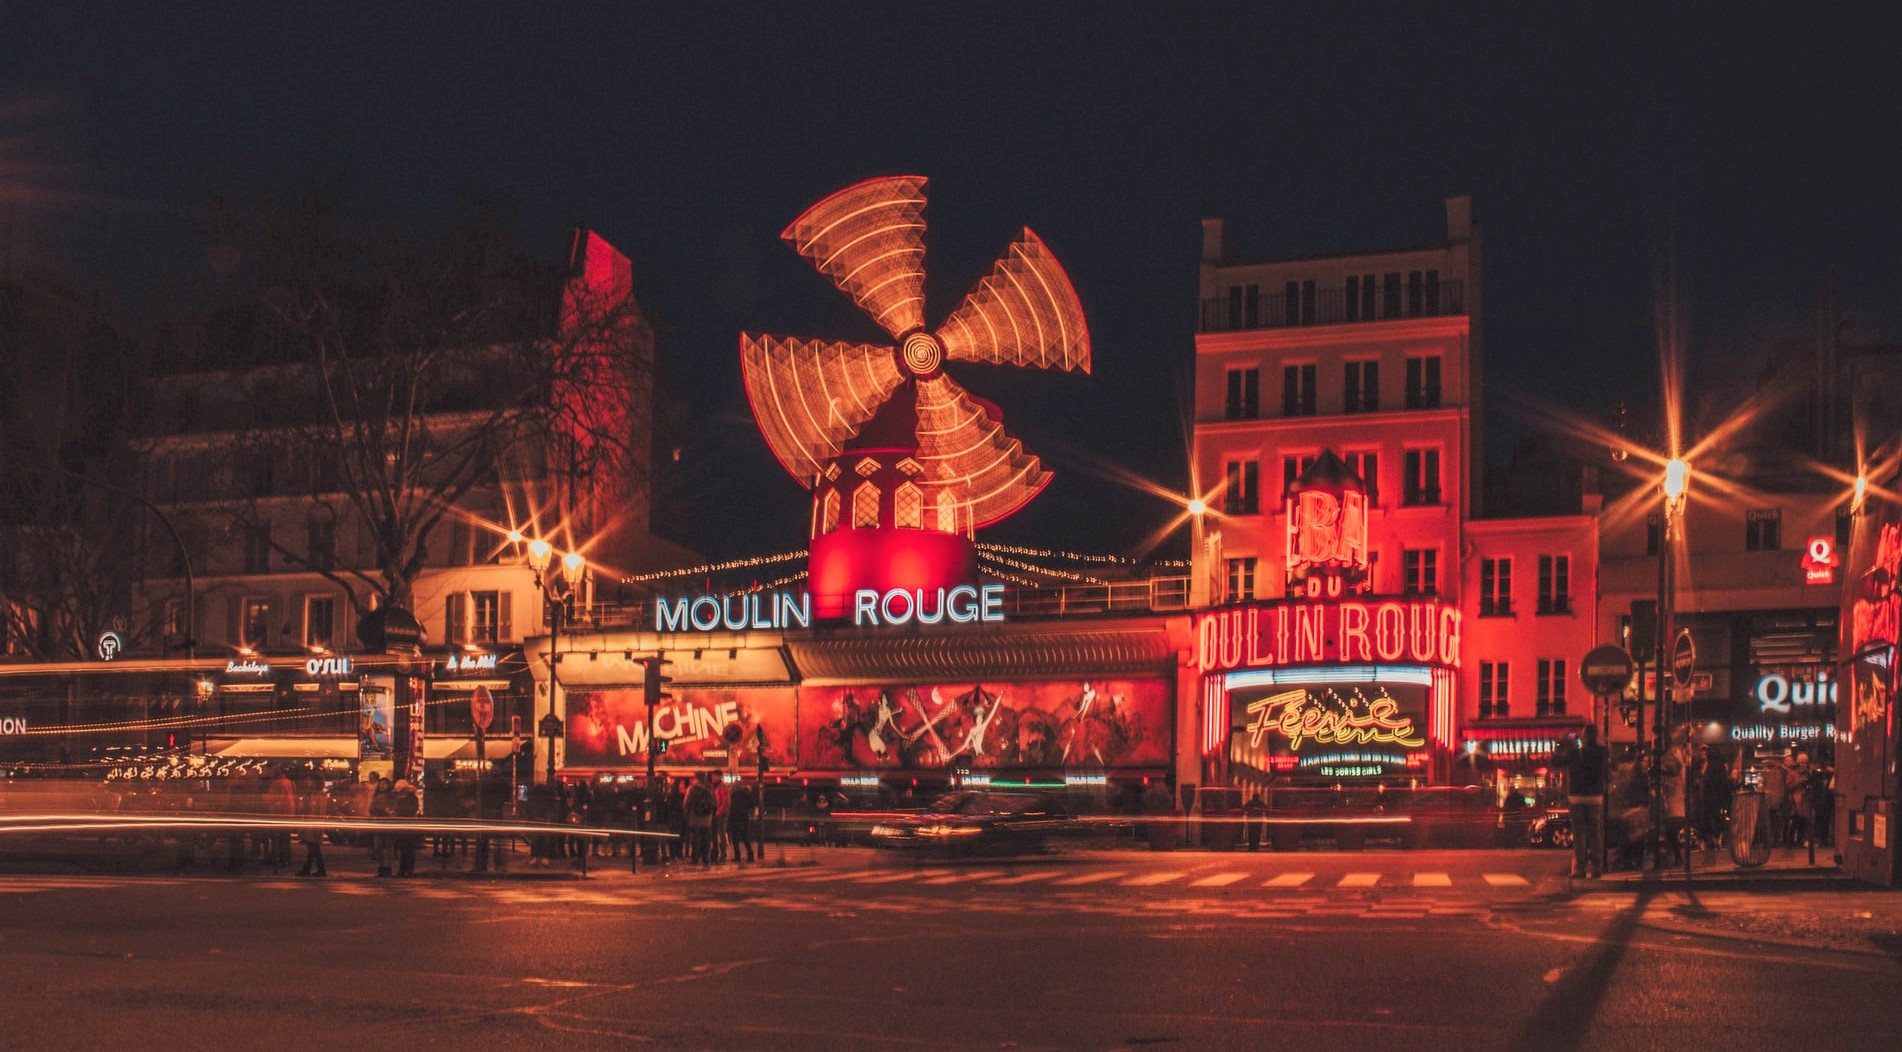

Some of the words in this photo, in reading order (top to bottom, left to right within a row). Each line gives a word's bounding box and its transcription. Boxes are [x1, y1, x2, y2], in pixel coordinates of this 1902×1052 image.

[1810, 539, 1831, 564] Q
[1307, 576, 1342, 598] DU
[655, 592, 811, 631] MOULIN
[855, 584, 1006, 626] ROUGE
[1200, 604, 1324, 674] OULIN
[1731, 724, 1775, 741] Quality
[1780, 724, 1821, 740] Burger
